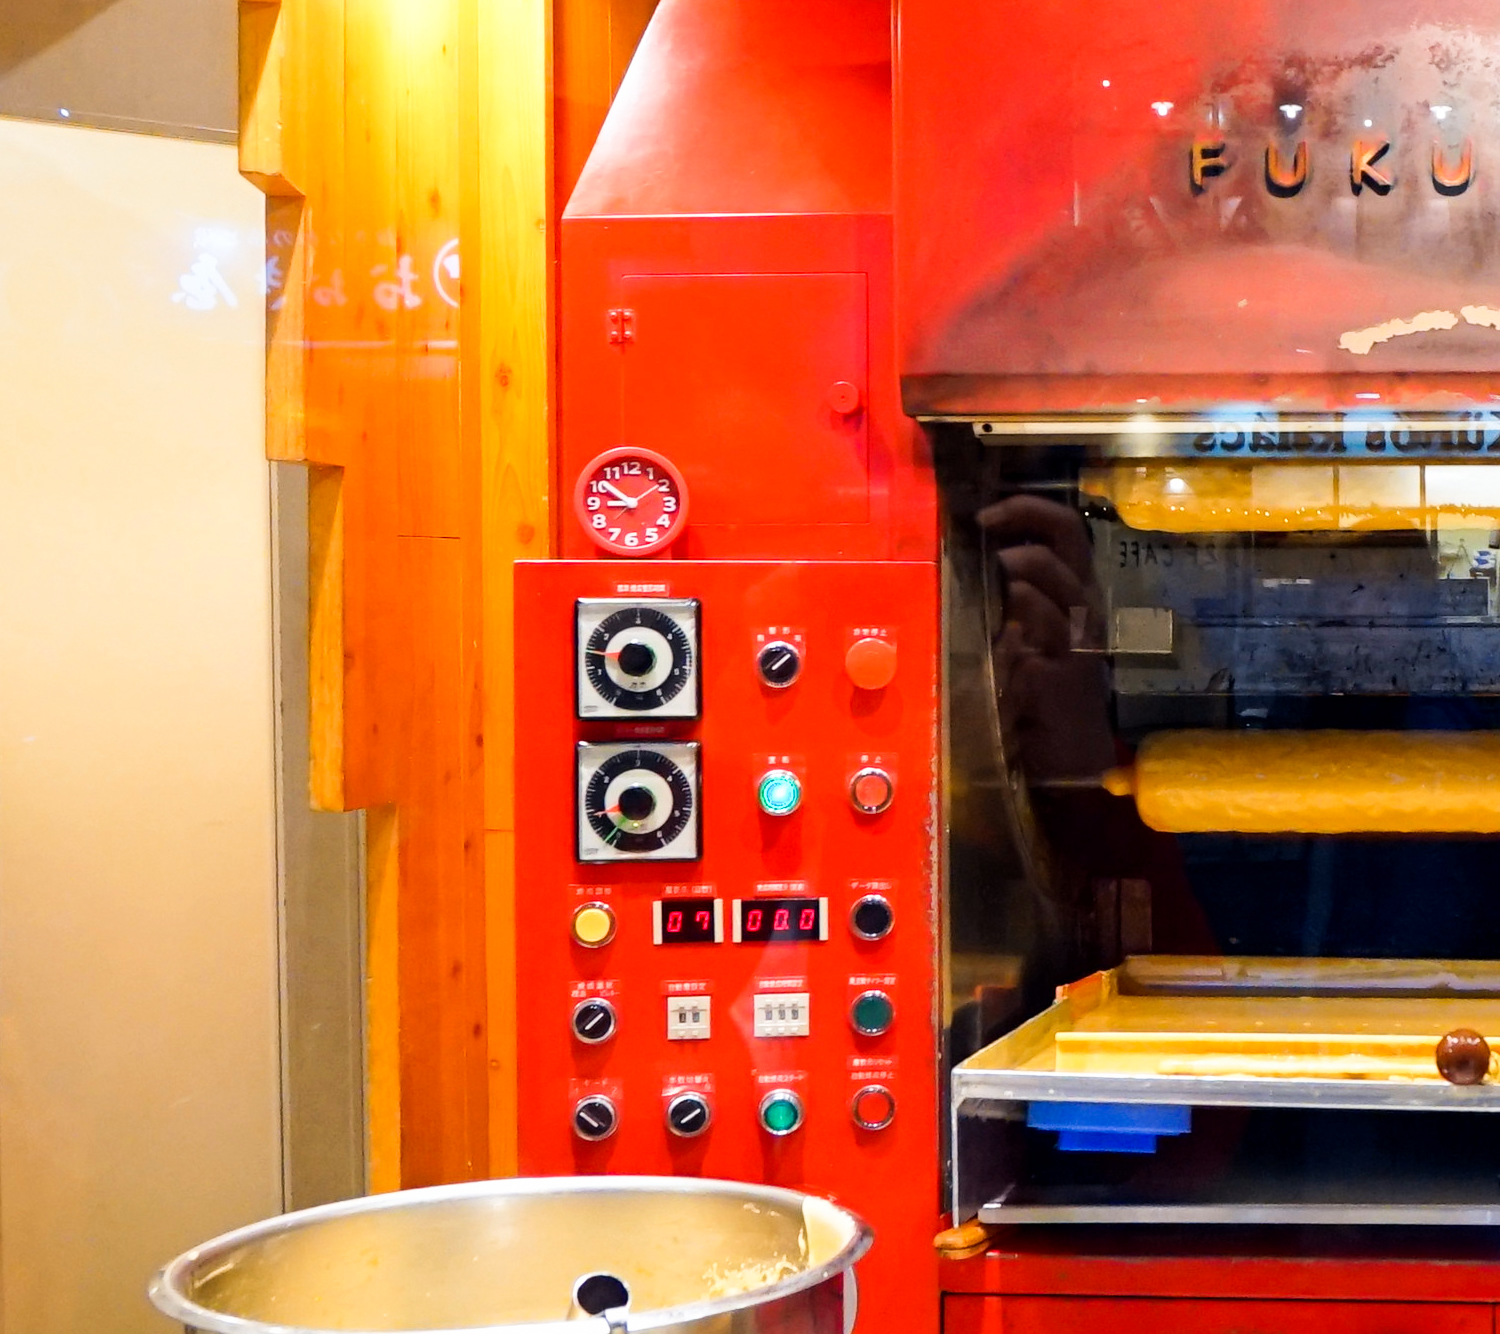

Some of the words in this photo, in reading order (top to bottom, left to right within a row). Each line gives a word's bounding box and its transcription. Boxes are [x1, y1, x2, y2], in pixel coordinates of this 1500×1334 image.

[603, 466, 621, 481] 11
[621, 461, 642, 476] 12
[646, 467, 654, 481] 1
[657, 479, 670, 493] 2
[587, 496, 601, 512] 9
[662, 496, 677, 513] 3
[592, 513, 607, 530] 8
[656, 513, 670, 529] 4
[608, 527, 621, 542] 7
[624, 531, 639, 548] 6
[645, 527, 659, 543] 5
[666, 910, 711, 933] 07
